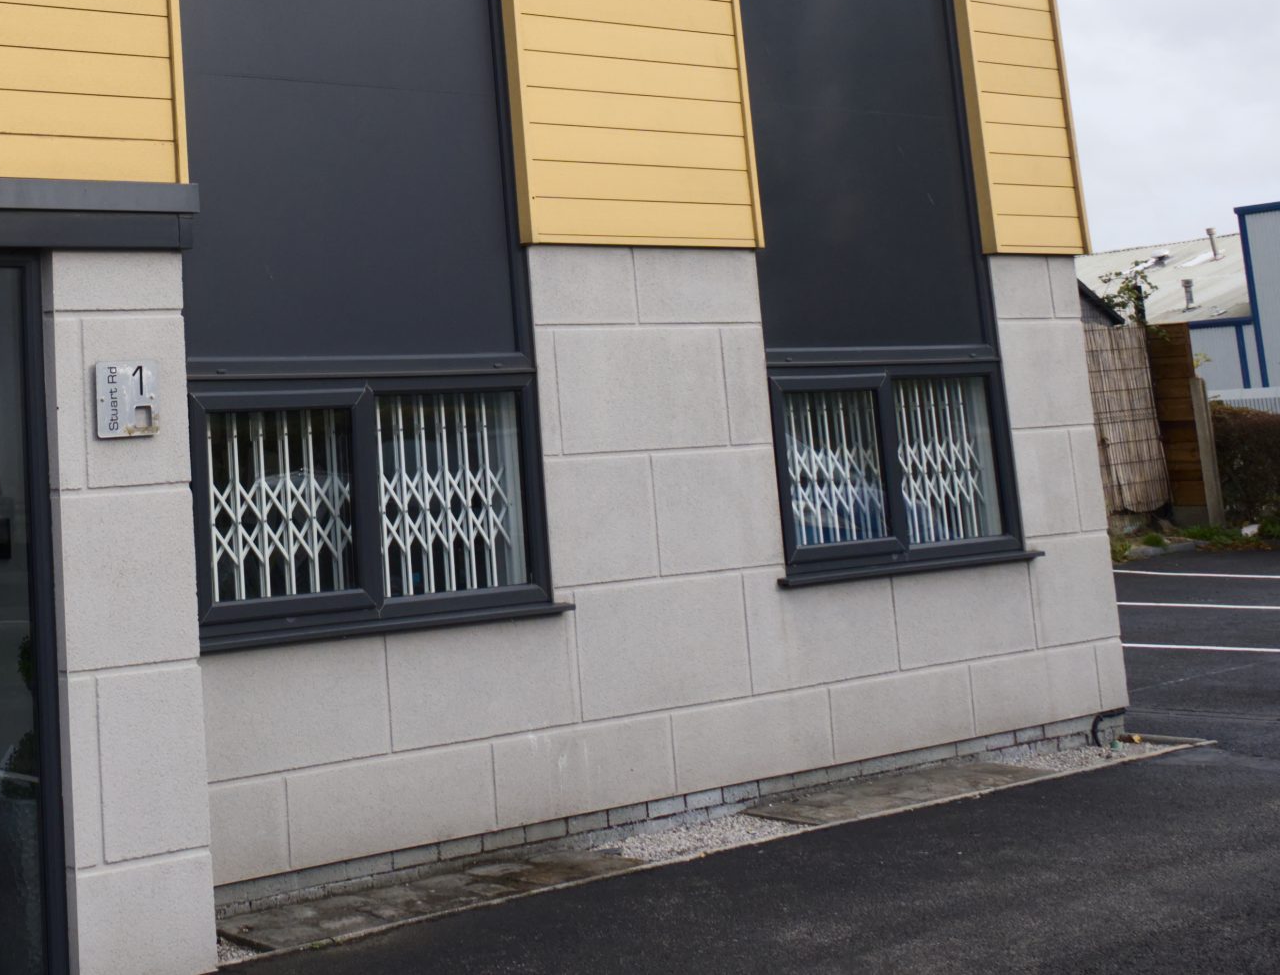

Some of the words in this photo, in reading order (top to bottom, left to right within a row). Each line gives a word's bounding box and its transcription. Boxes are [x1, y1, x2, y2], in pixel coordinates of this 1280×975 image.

[107, 366, 118, 384] Rd
[131, 365, 144, 396] 1
[108, 387, 119, 431] Stuart
